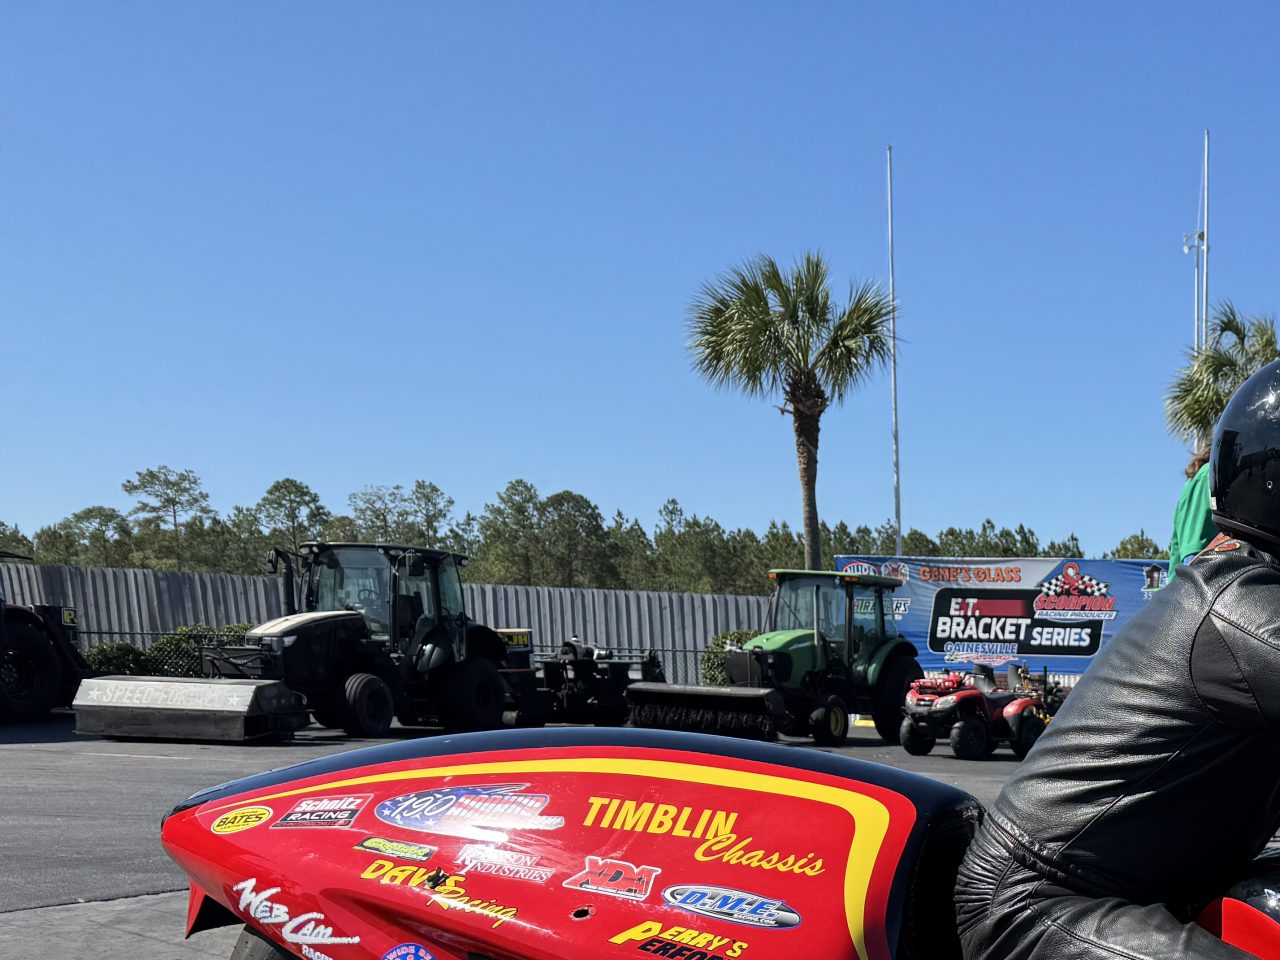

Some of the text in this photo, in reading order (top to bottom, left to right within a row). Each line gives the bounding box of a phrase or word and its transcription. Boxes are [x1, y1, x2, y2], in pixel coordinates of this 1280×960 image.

[919, 566, 1021, 583] GENE'S GLASS
[950, 598, 980, 617] E.T.
[1035, 594, 1115, 611] SCORPION
[1069, 611, 1115, 620] PRODUCTS
[936, 617, 1091, 647] BRACKET SERIES
[944, 641, 1018, 655] GAINESVILLE
[102, 686, 155, 703] SPEED
[294, 796, 364, 812] Schnitz
[216, 812, 268, 829] BATES
[287, 810, 352, 822] RACING
[583, 796, 738, 839] TIMBLIN
[694, 834, 825, 876] Chassis
[455, 859, 551, 881] INDUSTRIES
[566, 859, 660, 897] XDA
[427, 887, 518, 928] Racing
[680, 890, 780, 918] D.M.E.
[608, 920, 749, 958] PERRY'S
